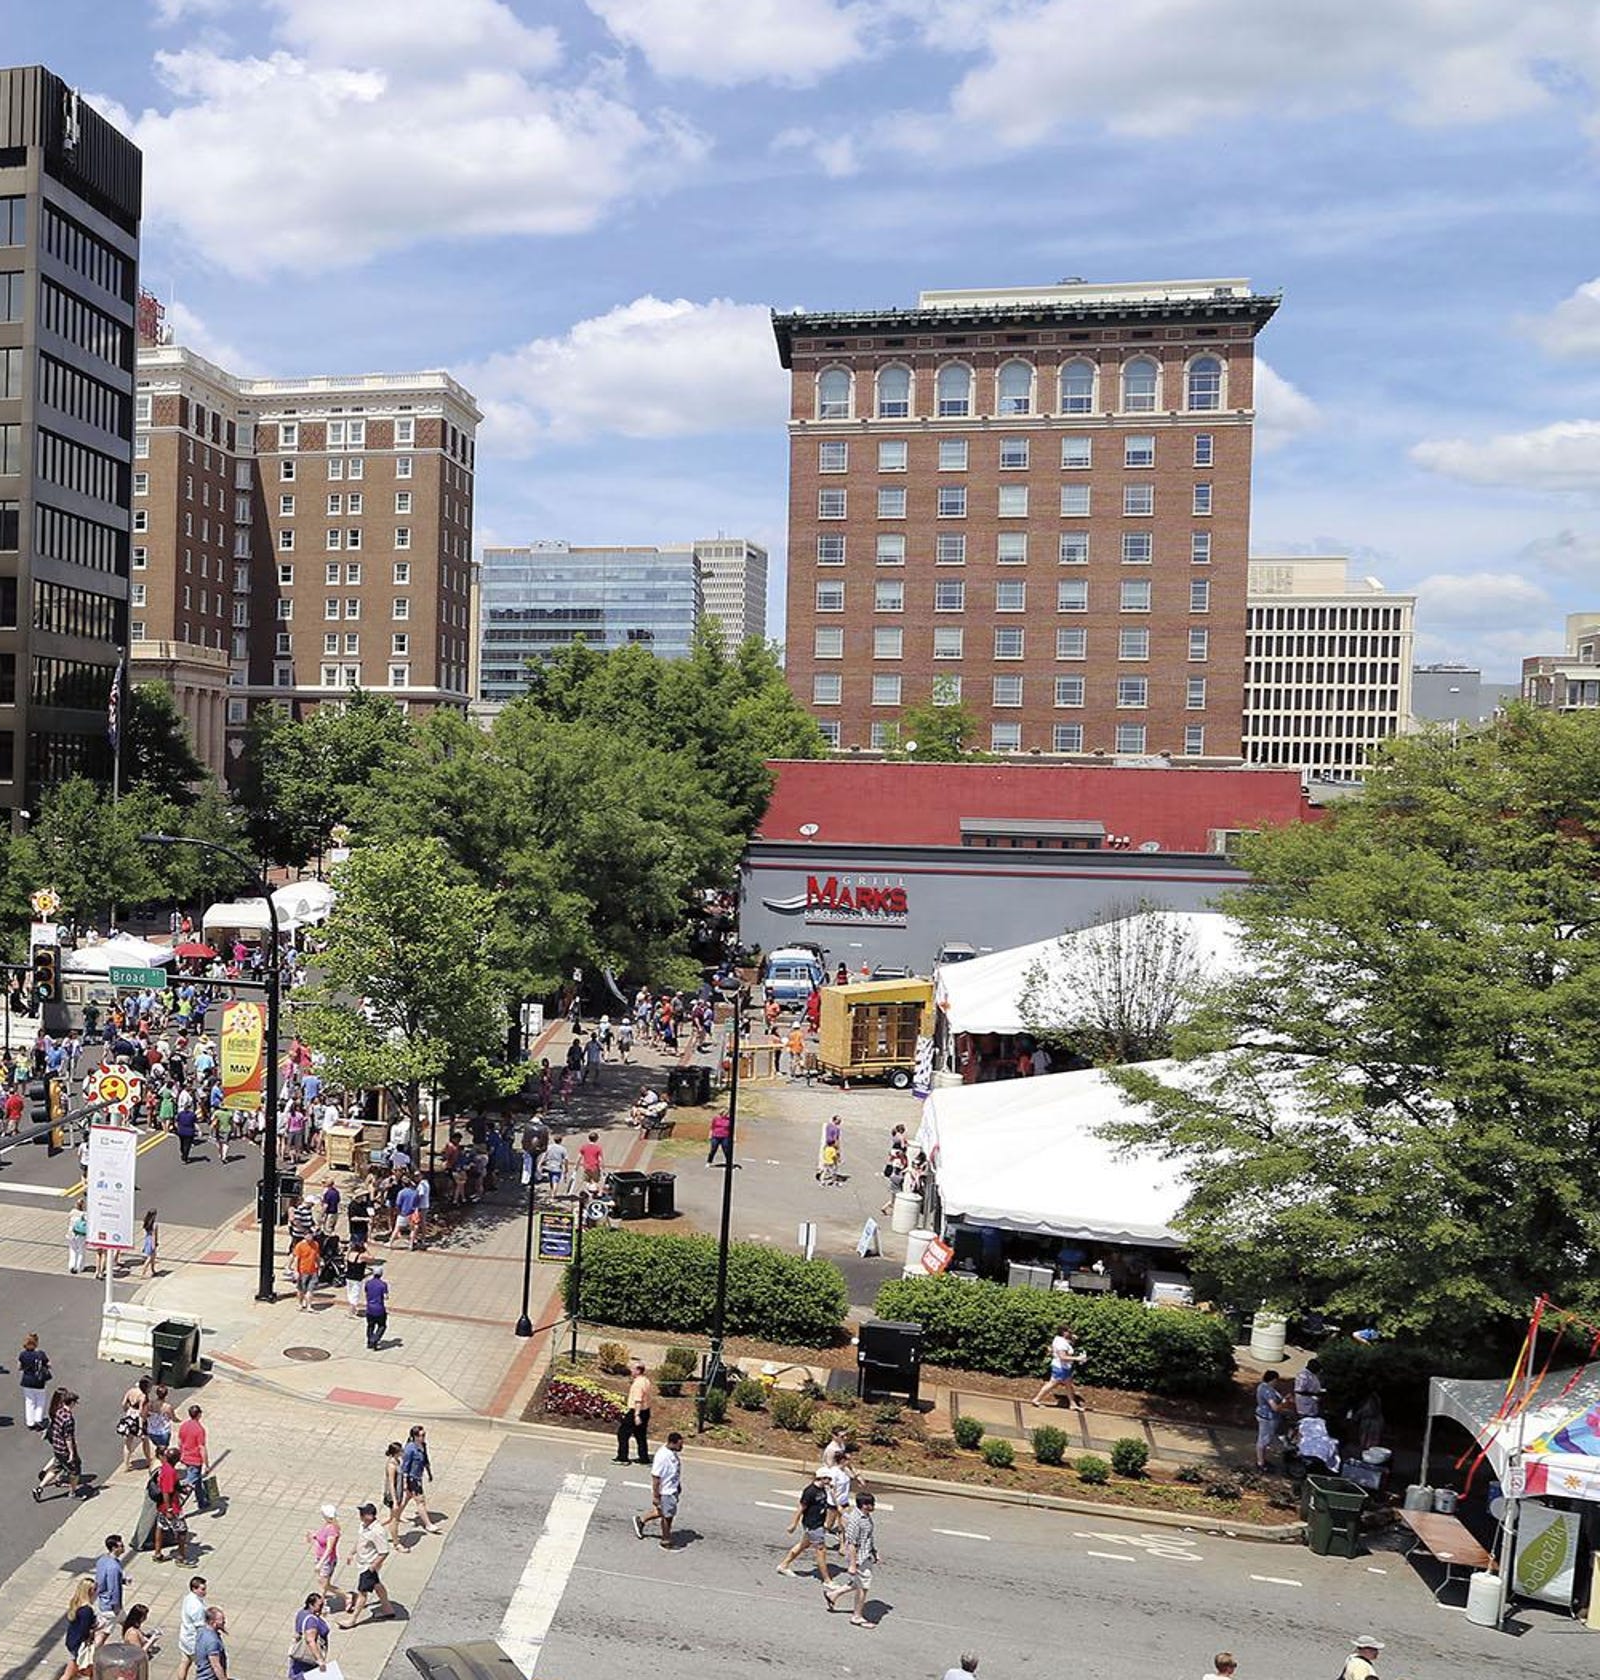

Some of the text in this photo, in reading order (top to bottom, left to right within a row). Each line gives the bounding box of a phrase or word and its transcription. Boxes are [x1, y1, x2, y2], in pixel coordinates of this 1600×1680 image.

[842, 876, 905, 886] GRILL
[113, 970, 145, 983] Broad
[230, 1064, 252, 1074] MAY
